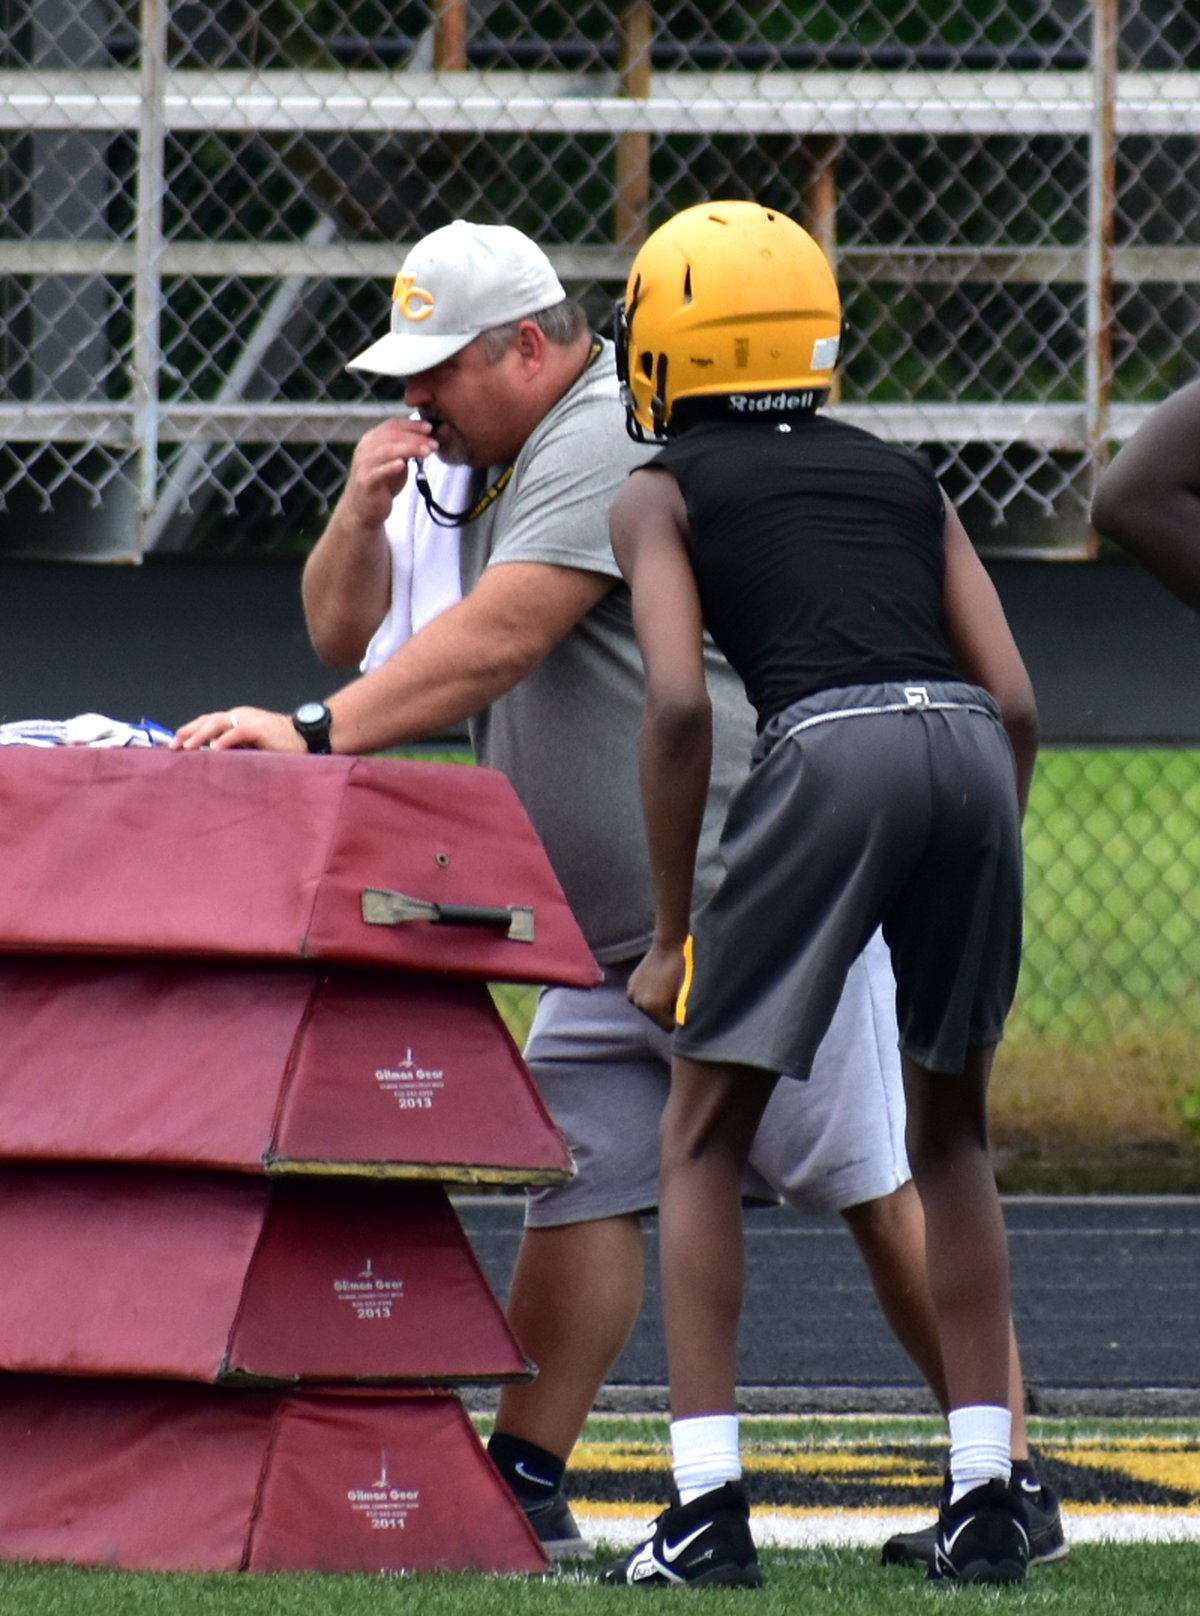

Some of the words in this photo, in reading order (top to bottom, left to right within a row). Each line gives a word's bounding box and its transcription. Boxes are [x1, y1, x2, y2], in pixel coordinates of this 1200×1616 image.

[729, 391, 814, 412] Riddell
[375, 1068, 414, 1081] Gilman
[416, 1068, 443, 1080] Gear
[399, 1097, 432, 1109] 2013
[357, 1307, 391, 1319] 2013
[347, 1489, 388, 1502] Gilman
[389, 1488, 419, 1501] Gear
[372, 1518, 405, 1530] 2011
